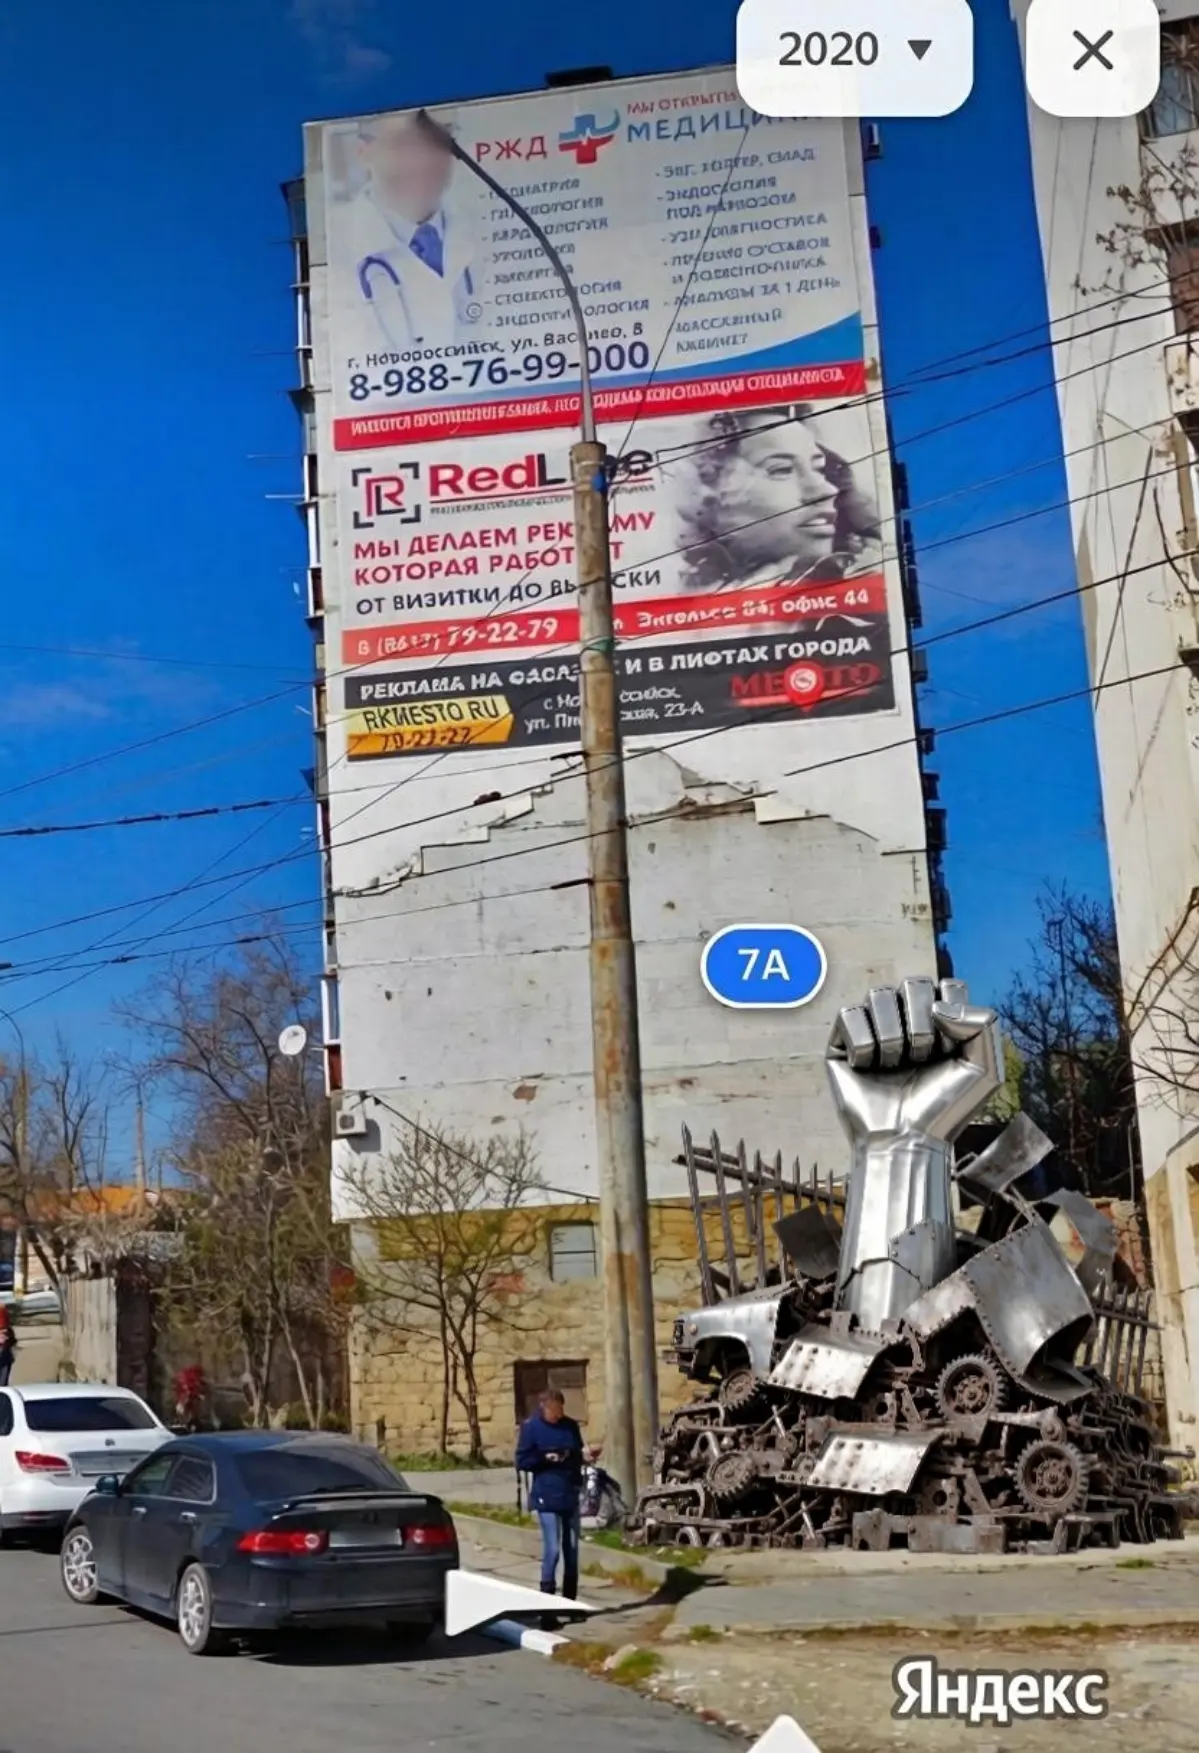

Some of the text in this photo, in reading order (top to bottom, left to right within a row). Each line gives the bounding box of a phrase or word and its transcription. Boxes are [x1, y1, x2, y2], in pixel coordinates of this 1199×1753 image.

[475, 136, 548, 162] РЖД
[349, 340, 650, 401] 8-988-76-99-000
[354, 539, 399, 560] МЫ
[407, 526, 517, 558] ДЕЛАЕМ
[354, 541, 625, 586] КОТОРАЯ РАБОТТ
[356, 598, 383, 615] ОТ
[393, 586, 501, 611] ВИЗИТКИ
[506, 582, 543, 602] ДО
[843, 588, 870, 605] 44
[360, 675, 465, 701] РЕКЛАМА
[470, 671, 503, 691] НА
[624, 656, 643, 676] И
[647, 656, 665, 674] В
[773, 637, 873, 661] ГОРОДА
